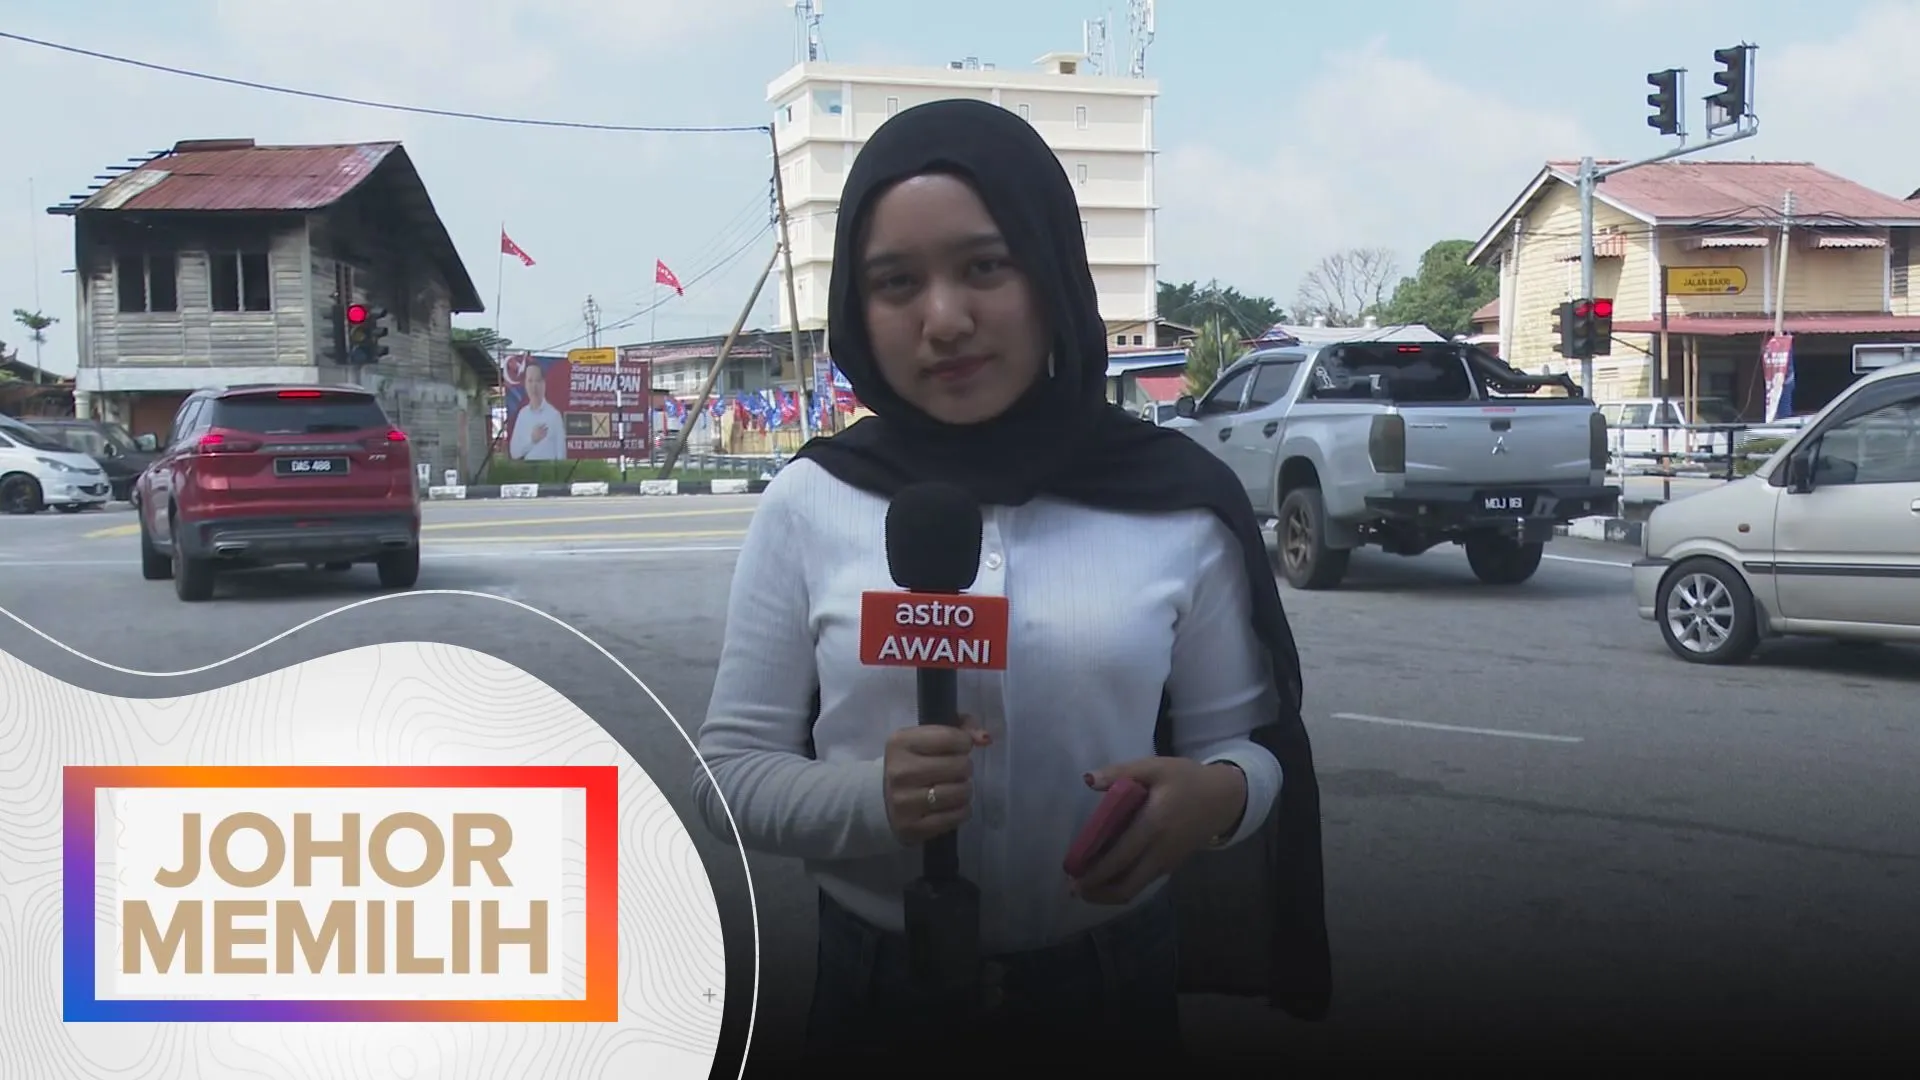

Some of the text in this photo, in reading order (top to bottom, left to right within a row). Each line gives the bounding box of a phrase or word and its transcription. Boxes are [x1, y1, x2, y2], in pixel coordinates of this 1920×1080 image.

[1683, 278, 1707, 286] JALAN
[895, 600, 974, 627] astro
[878, 635, 990, 664] AWANI
